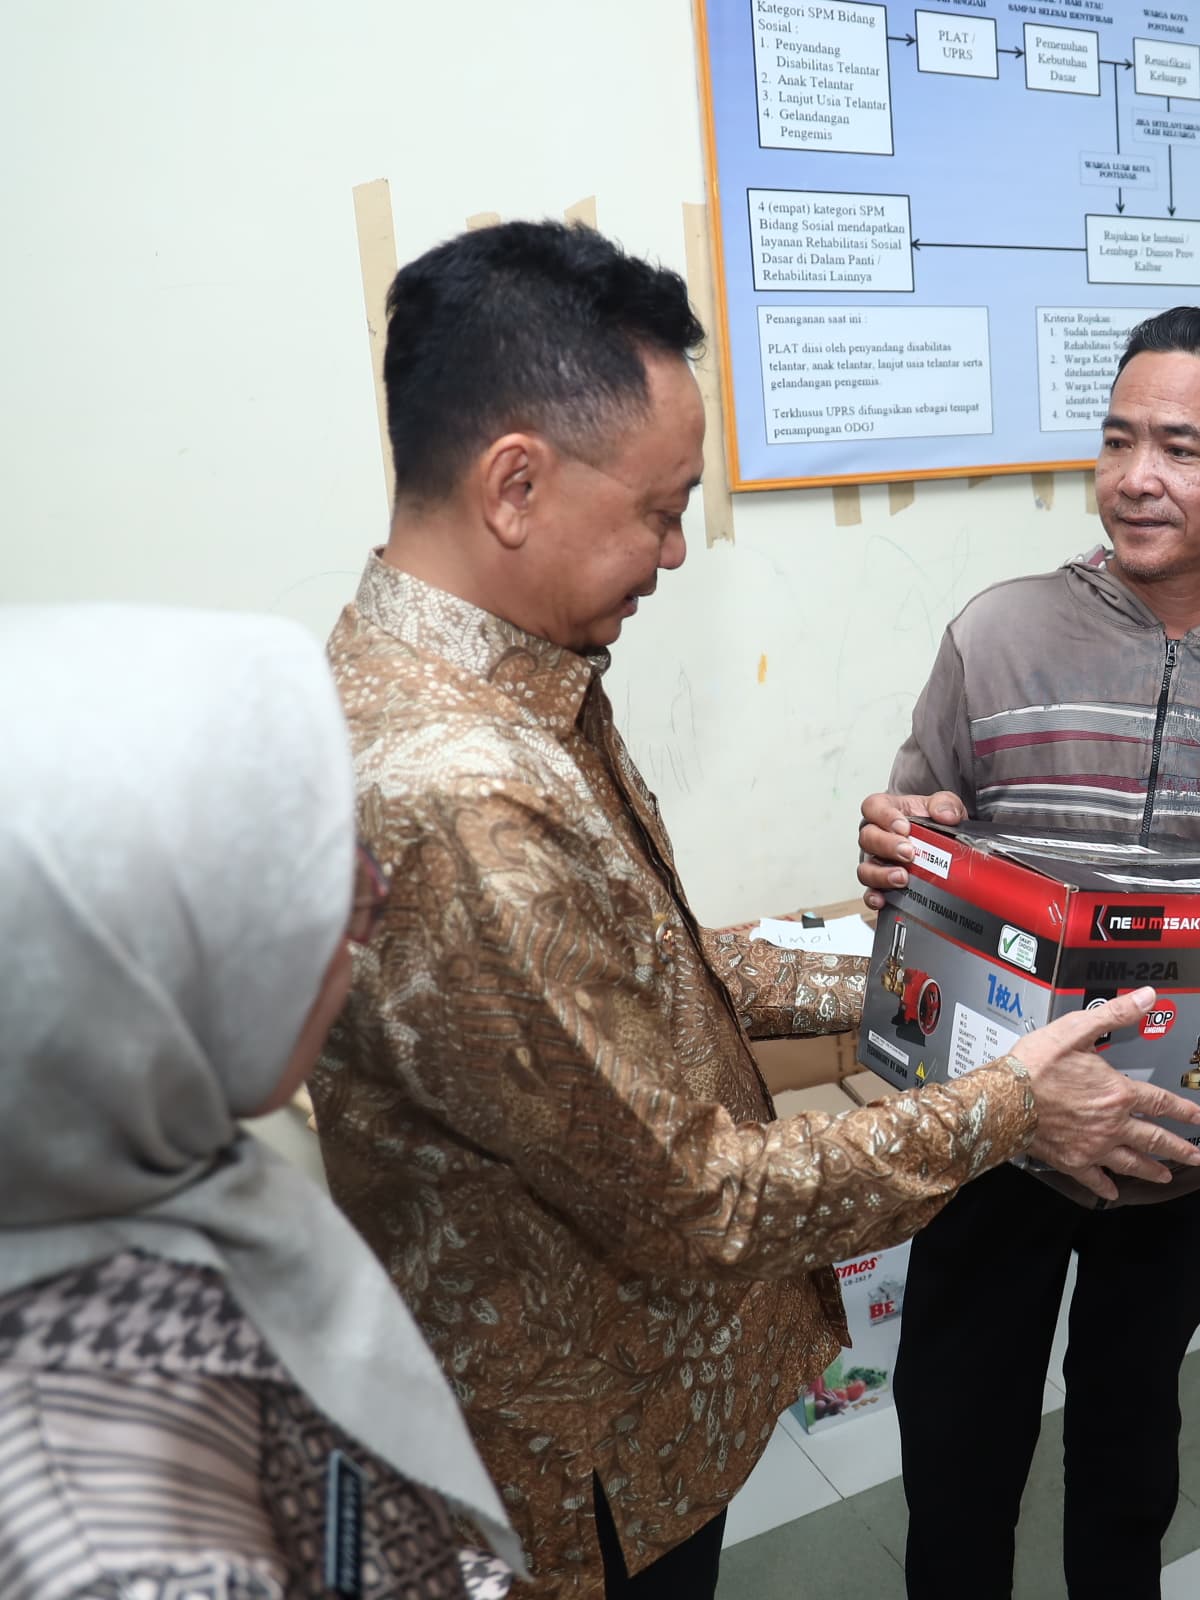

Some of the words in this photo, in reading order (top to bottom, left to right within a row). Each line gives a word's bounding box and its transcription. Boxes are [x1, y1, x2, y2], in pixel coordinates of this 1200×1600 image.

[757, 0, 805, 17] Kategori
[808, 7, 834, 21] SPM
[838, 10, 876, 26] Bidang
[758, 19, 791, 33] Sosial
[938, 30, 969, 44] PLAT
[760, 38, 769, 49] 1.
[775, 39, 841, 57] Penyandang
[1035, 37, 1088, 53] Pemenuhan
[942, 47, 973, 61] UPRS
[1038, 53, 1087, 69] Kebutuhan
[777, 56, 834, 73] Disabilitas
[836, 62, 880, 76] Telantar
[761, 73, 771, 85] 2.
[778, 74, 807, 88] Anak
[810, 77, 854, 91] Telantar
[1050, 69, 1076, 83] Dasar
[1150, 70, 1187, 85] Keluarga
[762, 91, 772, 102] 3.
[778, 92, 813, 107] Lanjut
[816, 94, 842, 108] Usia
[844, 97, 887, 111] Telantar
[763, 108, 773, 119] 4.
[779, 109, 850, 125] Gelandangan
[780, 126, 833, 142] Pengemis
[758, 201, 765, 212] 4
[768, 202, 811, 216] (empat)
[813, 203, 857, 219] kategori
[859, 206, 885, 217] SPM
[759, 218, 799, 233] Bidang
[801, 220, 834, 232] Sosial
[837, 221, 905, 236] mendapatkan
[760, 235, 803, 250] layanan
[806, 236, 869, 250] Rehabilitasi
[871, 238, 902, 250] Sosial
[1103, 230, 1139, 245] Rujukan
[1141, 231, 1151, 242] ke
[762, 252, 794, 265] Dasar
[796, 253, 807, 265] di
[810, 253, 846, 265] Dalam
[848, 254, 875, 266] Panti
[1099, 245, 1138, 259] Lembaga
[1134, 261, 1162, 273] Kalbar
[763, 269, 827, 282] Rehabilitasi
[830, 270, 873, 285] Lainnya
[765, 313, 826, 327] Penanganan
[828, 314, 846, 325] saat
[849, 314, 863, 324] ini
[1043, 313, 1076, 324] Kriteria
[1077, 313, 1111, 325] Rujukan
[1063, 327, 1089, 337] Sudah
[768, 343, 798, 354] PLAT
[825, 342, 846, 354] oleh
[848, 342, 904, 357] penyandang
[907, 341, 952, 352] disabilitas
[1064, 341, 1111, 351] Rehabilitasi
[769, 360, 810, 374] telantar,
[812, 360, 835, 371] anak
[877, 358, 904, 372] lanjut
[906, 358, 925, 369] usia
[926, 357, 960, 369] telantar
[962, 357, 983, 369] serta
[1064, 354, 1092, 365] Warga
[1093, 354, 1114, 364] Kota
[770, 377, 832, 392] gelandangan
[1065, 381, 1092, 392] Warga
[1065, 396, 1100, 406] identitas
[772, 407, 823, 420] Terkhusus
[826, 405, 856, 417] UPRS
[858, 403, 913, 418] difungsikan
[915, 402, 949, 417] sebagai
[950, 401, 980, 416] tempat
[1065, 410, 1091, 421] Orang
[773, 423, 842, 439] penampungan
[844, 421, 875, 435] ODGJ
[1110, 916, 1145, 930] NEW
[1085, 961, 1179, 982] NM-22A
[1146, 1010, 1174, 1027] TOP
